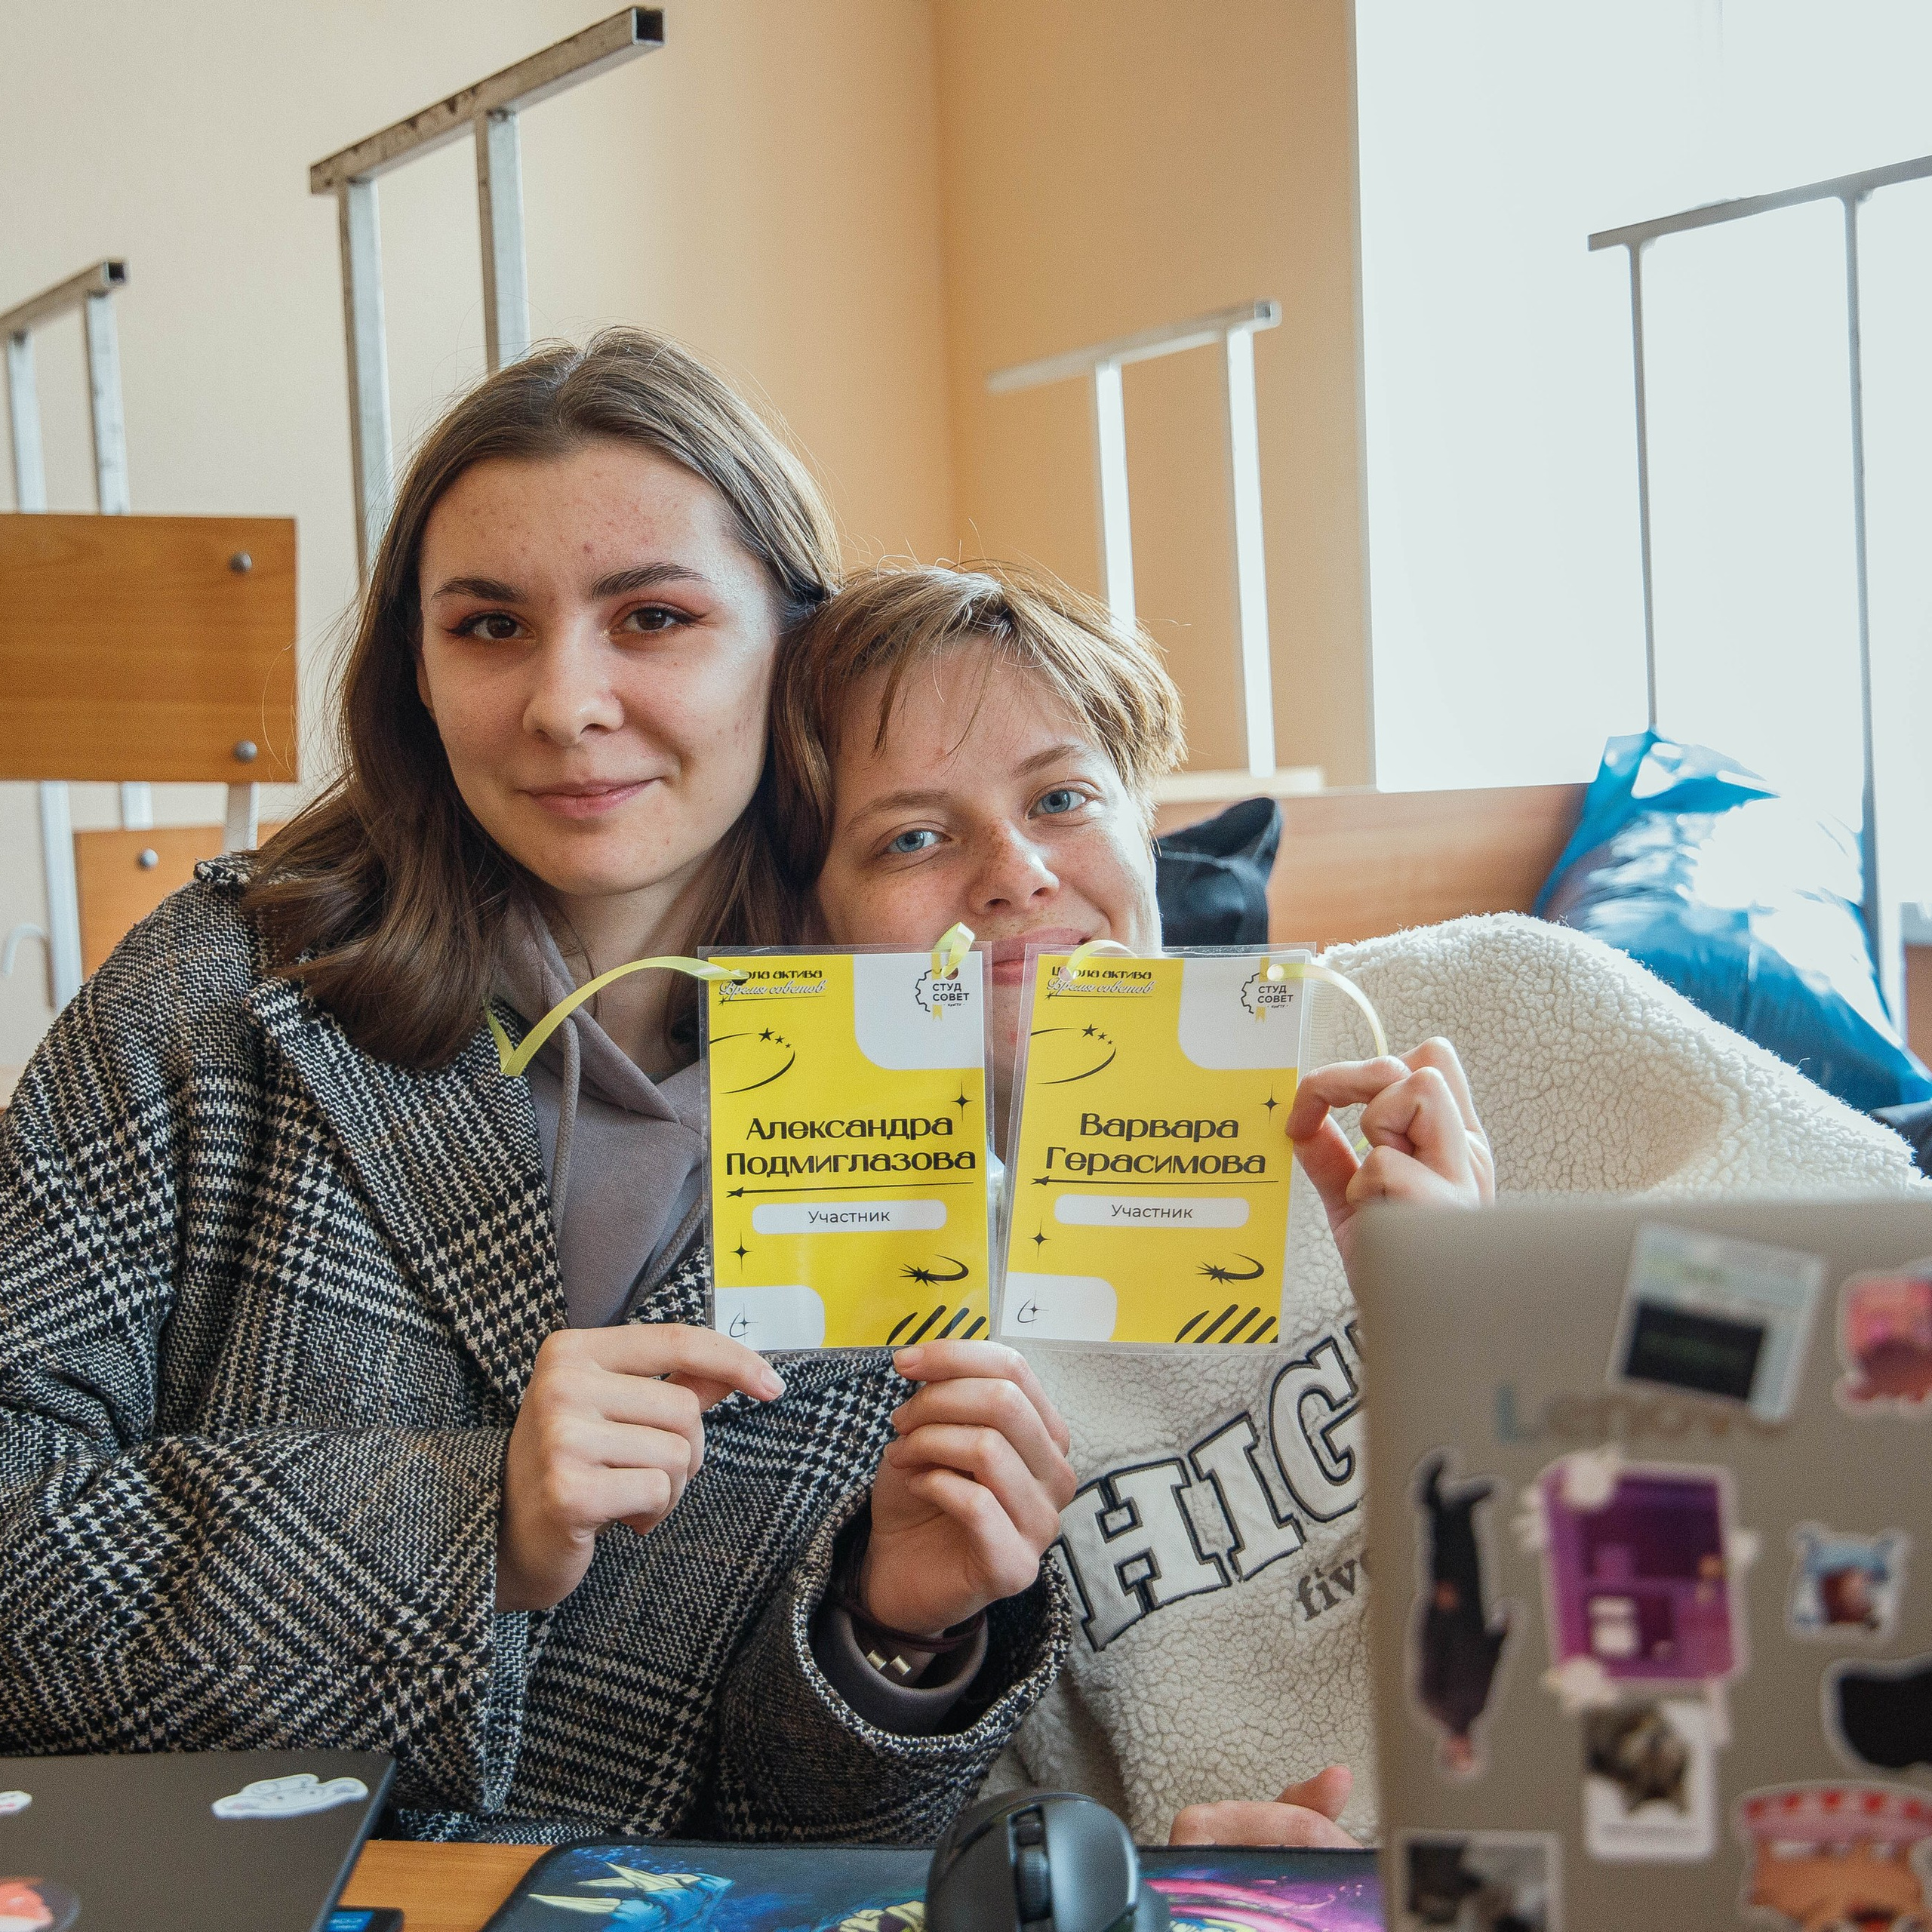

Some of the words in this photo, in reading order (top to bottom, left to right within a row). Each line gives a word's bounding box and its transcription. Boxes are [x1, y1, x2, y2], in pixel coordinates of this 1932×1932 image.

[772, 970, 823, 980] актива
[1051, 966, 1100, 978] Шола
[1101, 970, 1152, 980] актива
[718, 980, 768, 1001] Время
[769, 979, 829, 995] советов
[932, 983, 961, 992] СТУД
[1047, 977, 1096, 996] Время
[1097, 980, 1157, 995] советов
[1258, 985, 1287, 994] СТУД
[932, 992, 970, 1001] СОВЕТ
[1257, 994, 1294, 1004] СОВЕТ
[746, 1117, 953, 1140] Александра
[1079, 1112, 1239, 1143] Варвара
[726, 1150, 976, 1178] Подмиглазова
[1045, 1146, 1266, 1175] Герасимова
[808, 1210, 891, 1223] Участник
[1111, 1204, 1193, 1219] Участник
[1051, 1320, 1363, 1652] HIG
[1296, 1550, 1365, 1622] fiv
